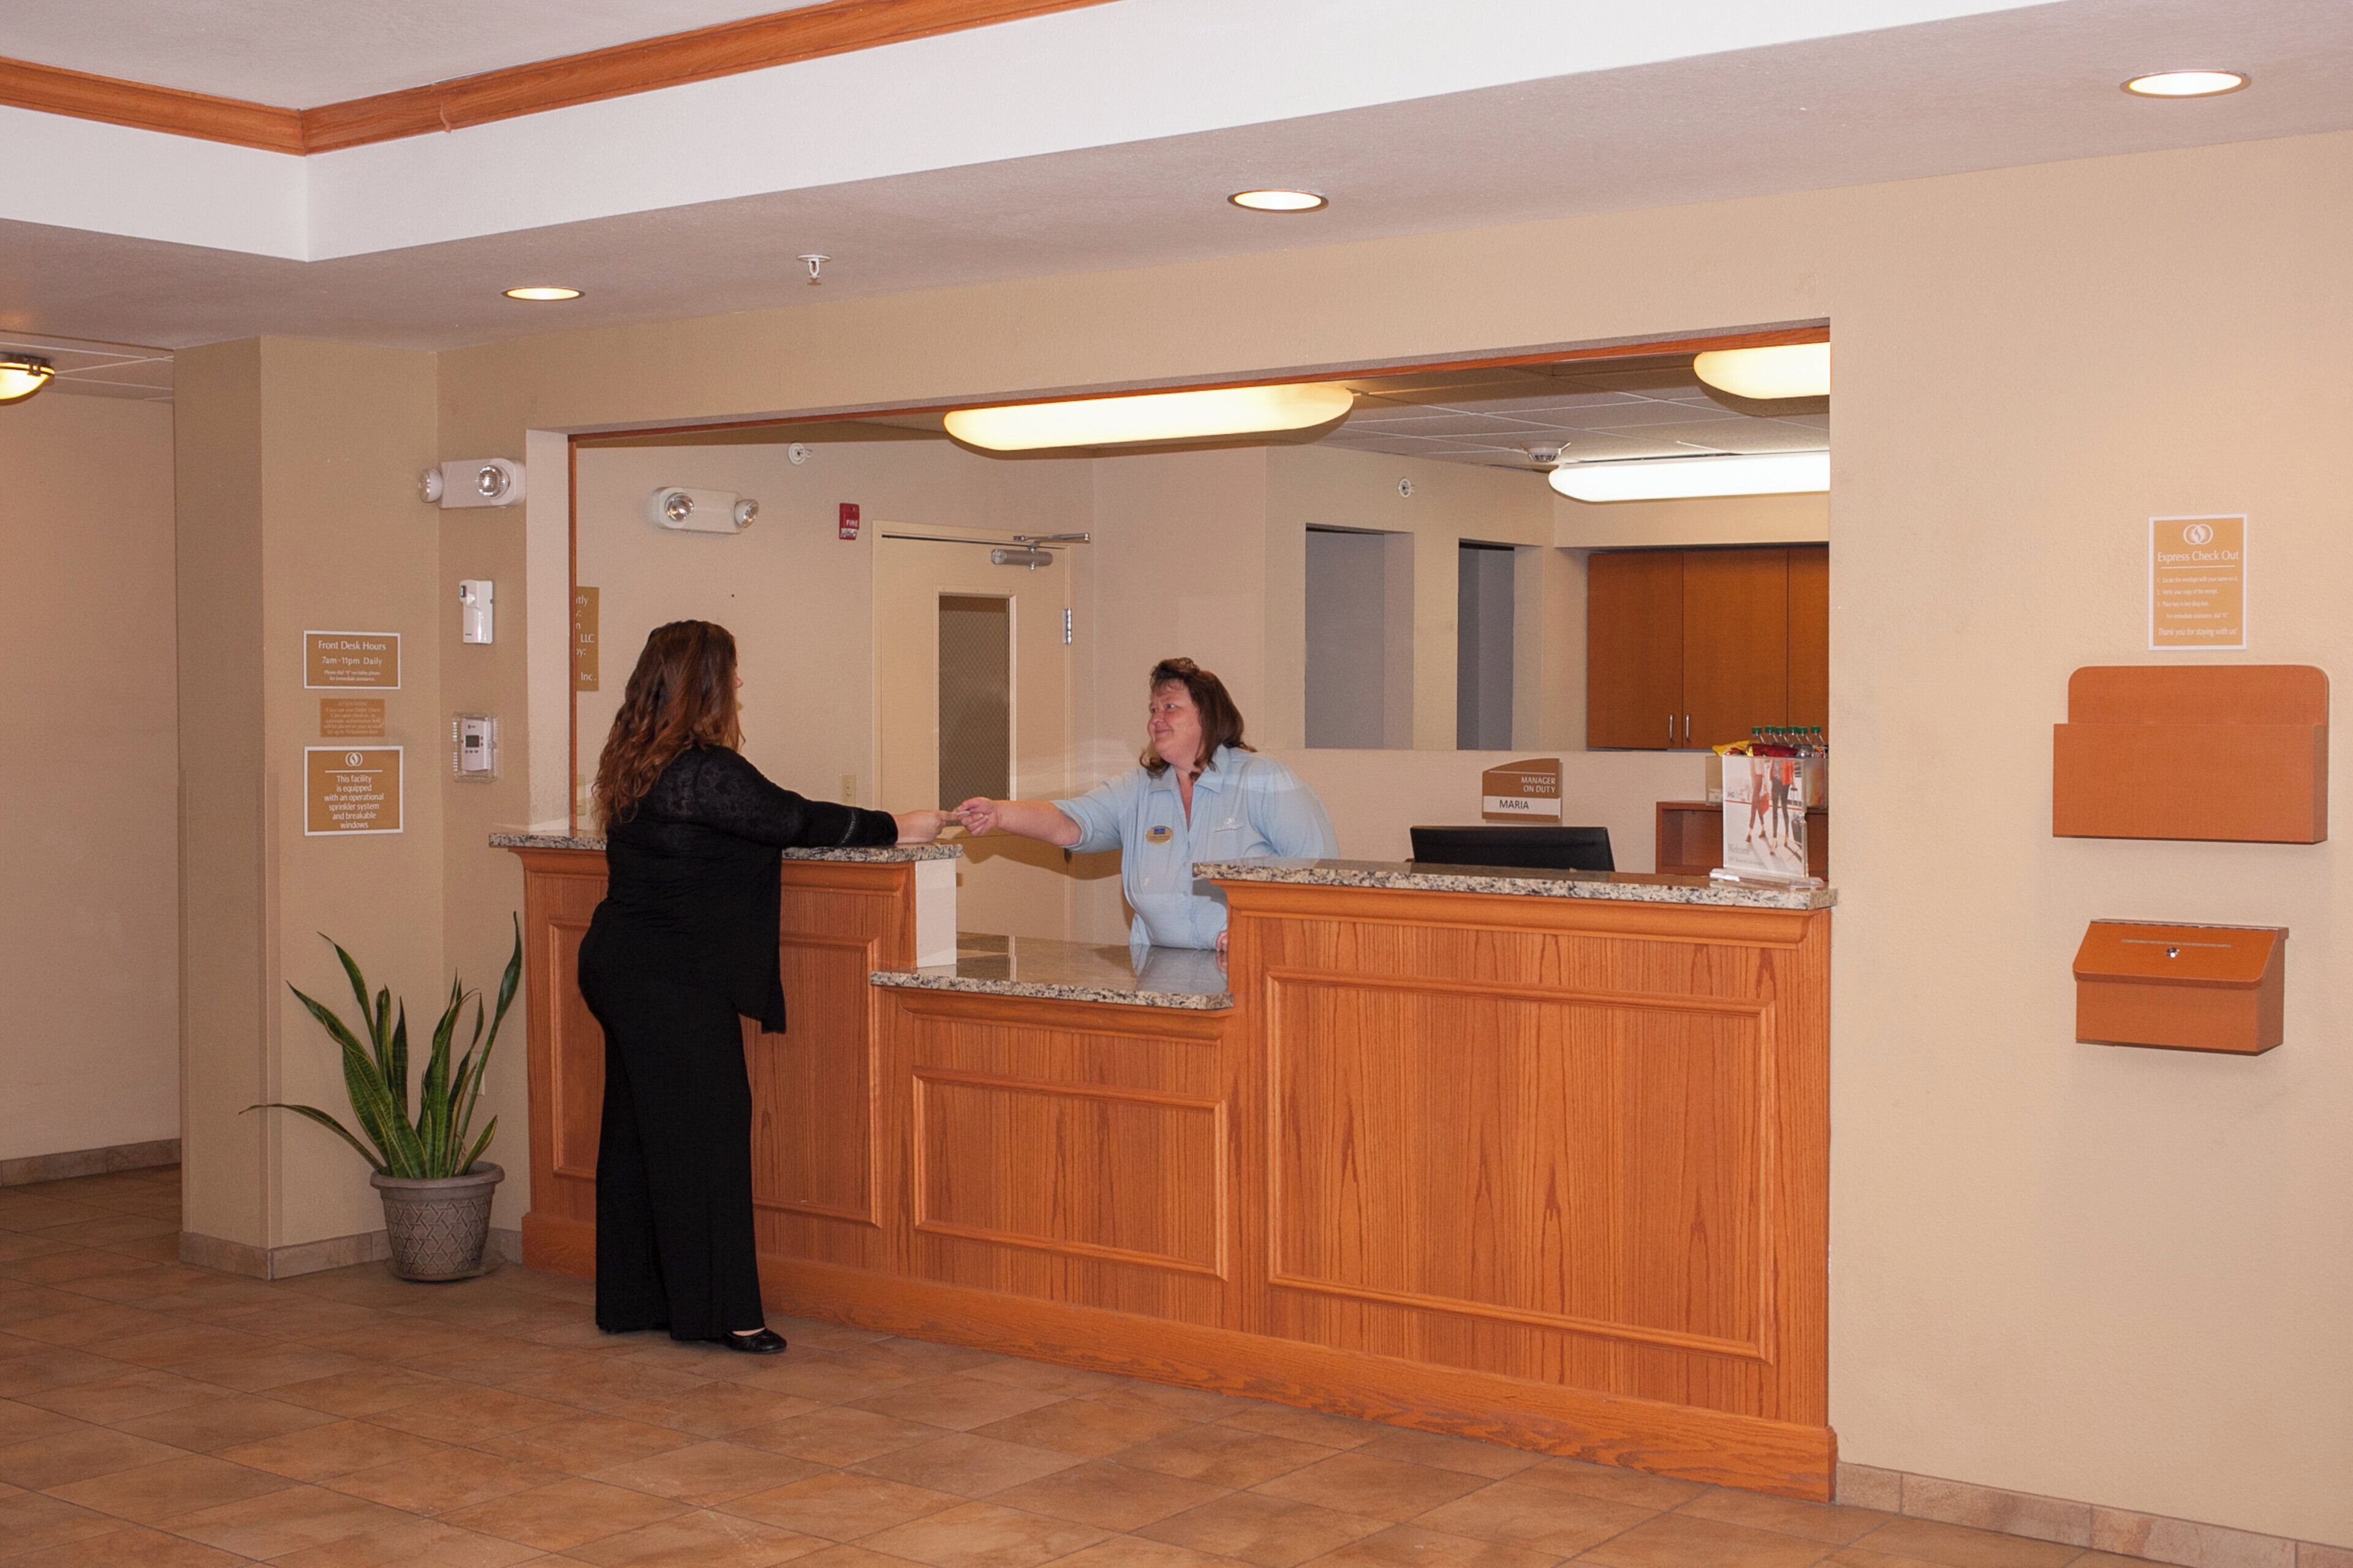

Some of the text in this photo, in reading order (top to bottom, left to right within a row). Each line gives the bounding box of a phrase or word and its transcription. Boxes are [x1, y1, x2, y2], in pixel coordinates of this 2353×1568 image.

[2157, 550, 2239, 564] Express Check Out
[2158, 627, 2174, 635] Thank
[2175, 629, 2186, 638] you
[2195, 627, 2214, 638] staying
[2215, 626, 2227, 635] with
[580, 634, 594, 643] LLC
[318, 640, 386, 651] Front Desk Hours
[363, 657, 382, 667] Daily
[580, 672, 597, 681] Inc.
[351, 775, 371, 784] facility
[349, 793, 384, 802] operational
[328, 803, 355, 812] sprinkler
[1499, 800, 1529, 809] MARIA
